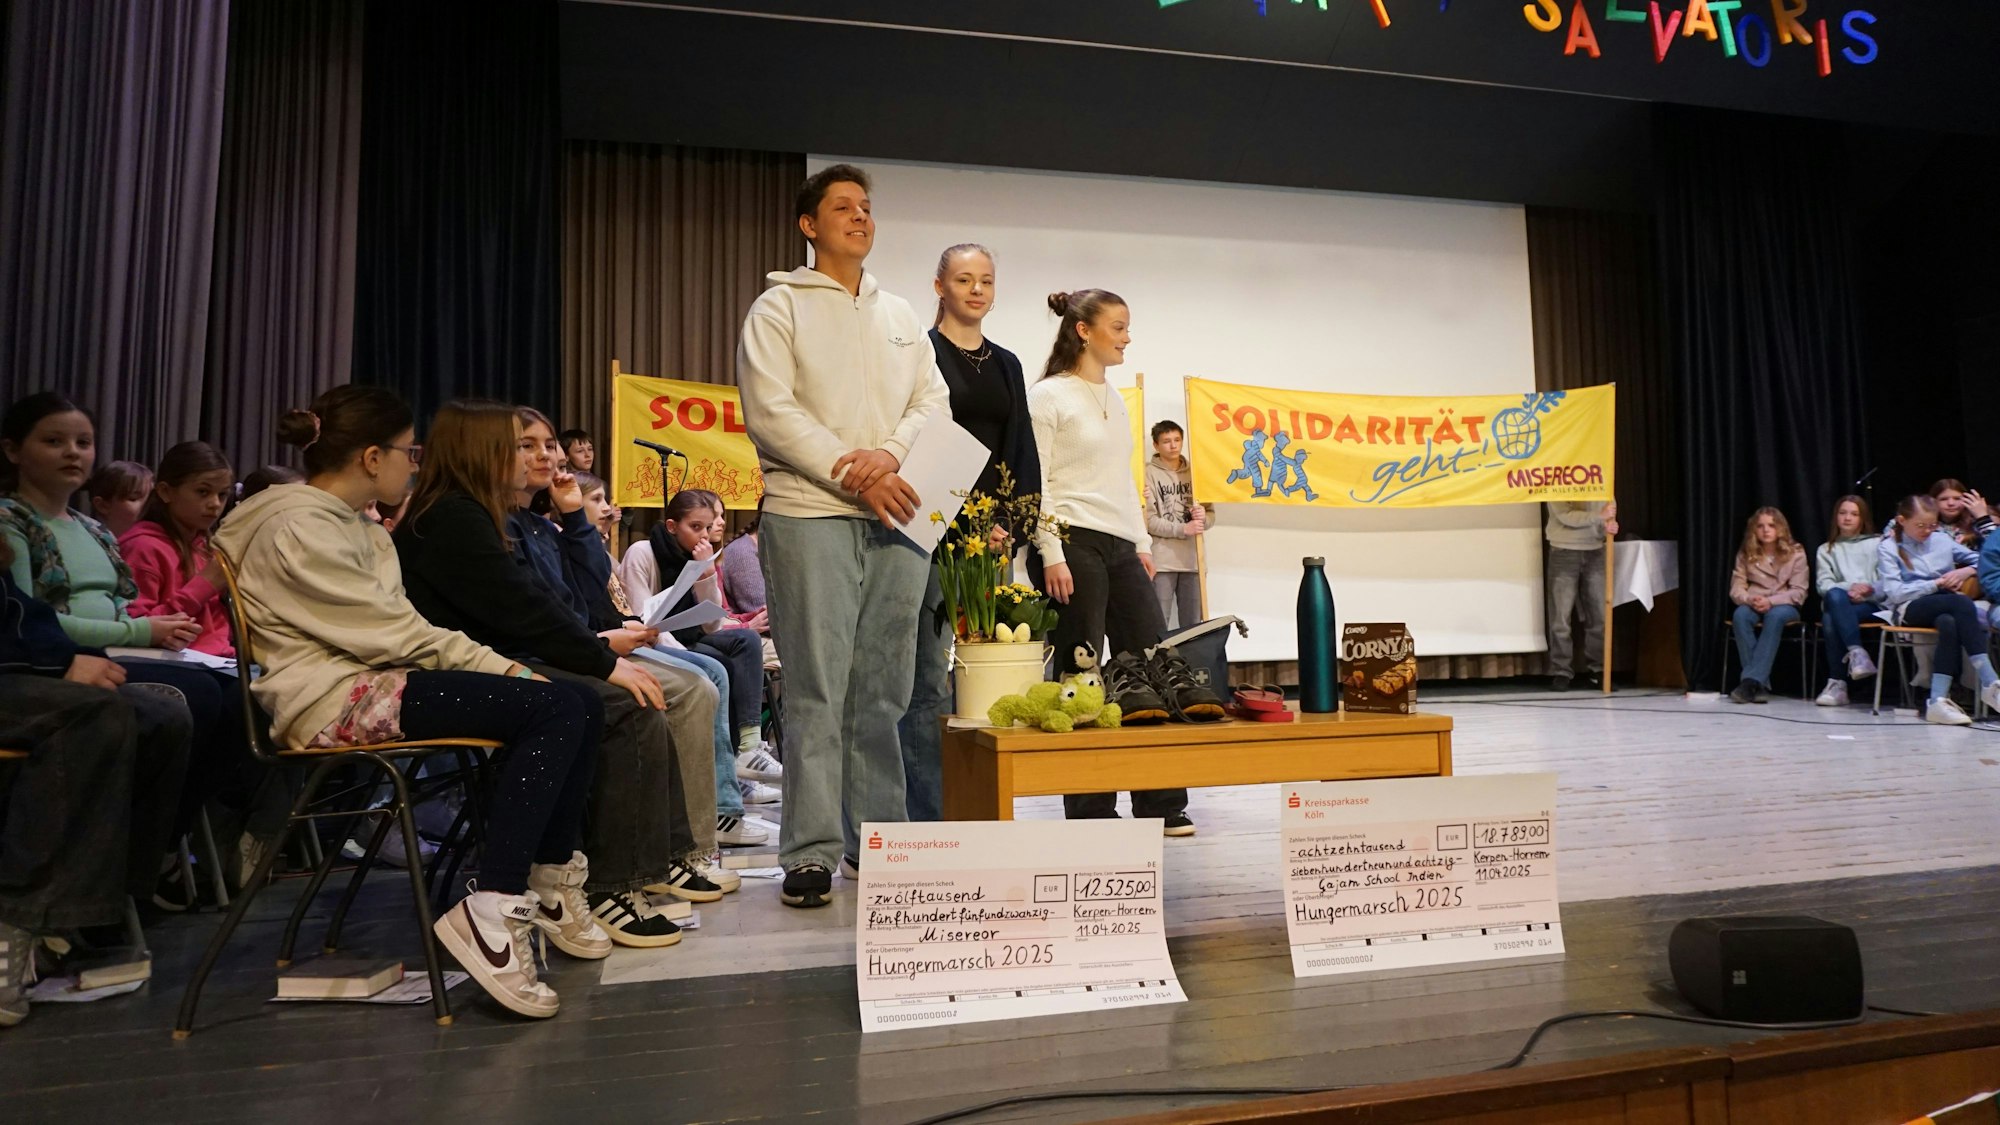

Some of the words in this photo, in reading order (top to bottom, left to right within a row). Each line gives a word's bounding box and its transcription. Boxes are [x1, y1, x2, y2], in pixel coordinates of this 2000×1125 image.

[1215, 403, 1486, 446] SOLIDARITÄT
[1507, 464, 1603, 488] MISEREOR
[1304, 797, 1370, 808] Kreissparkasse
[1304, 811, 1324, 819] Köln
[887, 840, 960, 850] Kreissparkasse
[886, 853, 909, 862] Köln
[1474, 848, 1550, 866] Kerpen-Horrem
[1364, 872, 1400, 887] School
[511, 905, 532, 917] NIKE
[1074, 903, 1157, 920] Kerpen-Horrem
[1295, 890, 1409, 925] Hungermarsch
[1415, 886, 1463, 909] 2025
[919, 926, 1000, 943] Misereor
[1076, 922, 1141, 937] 11.04.2025
[869, 948, 995, 980] Hungermarsch
[1001, 944, 1053, 966] 2025
